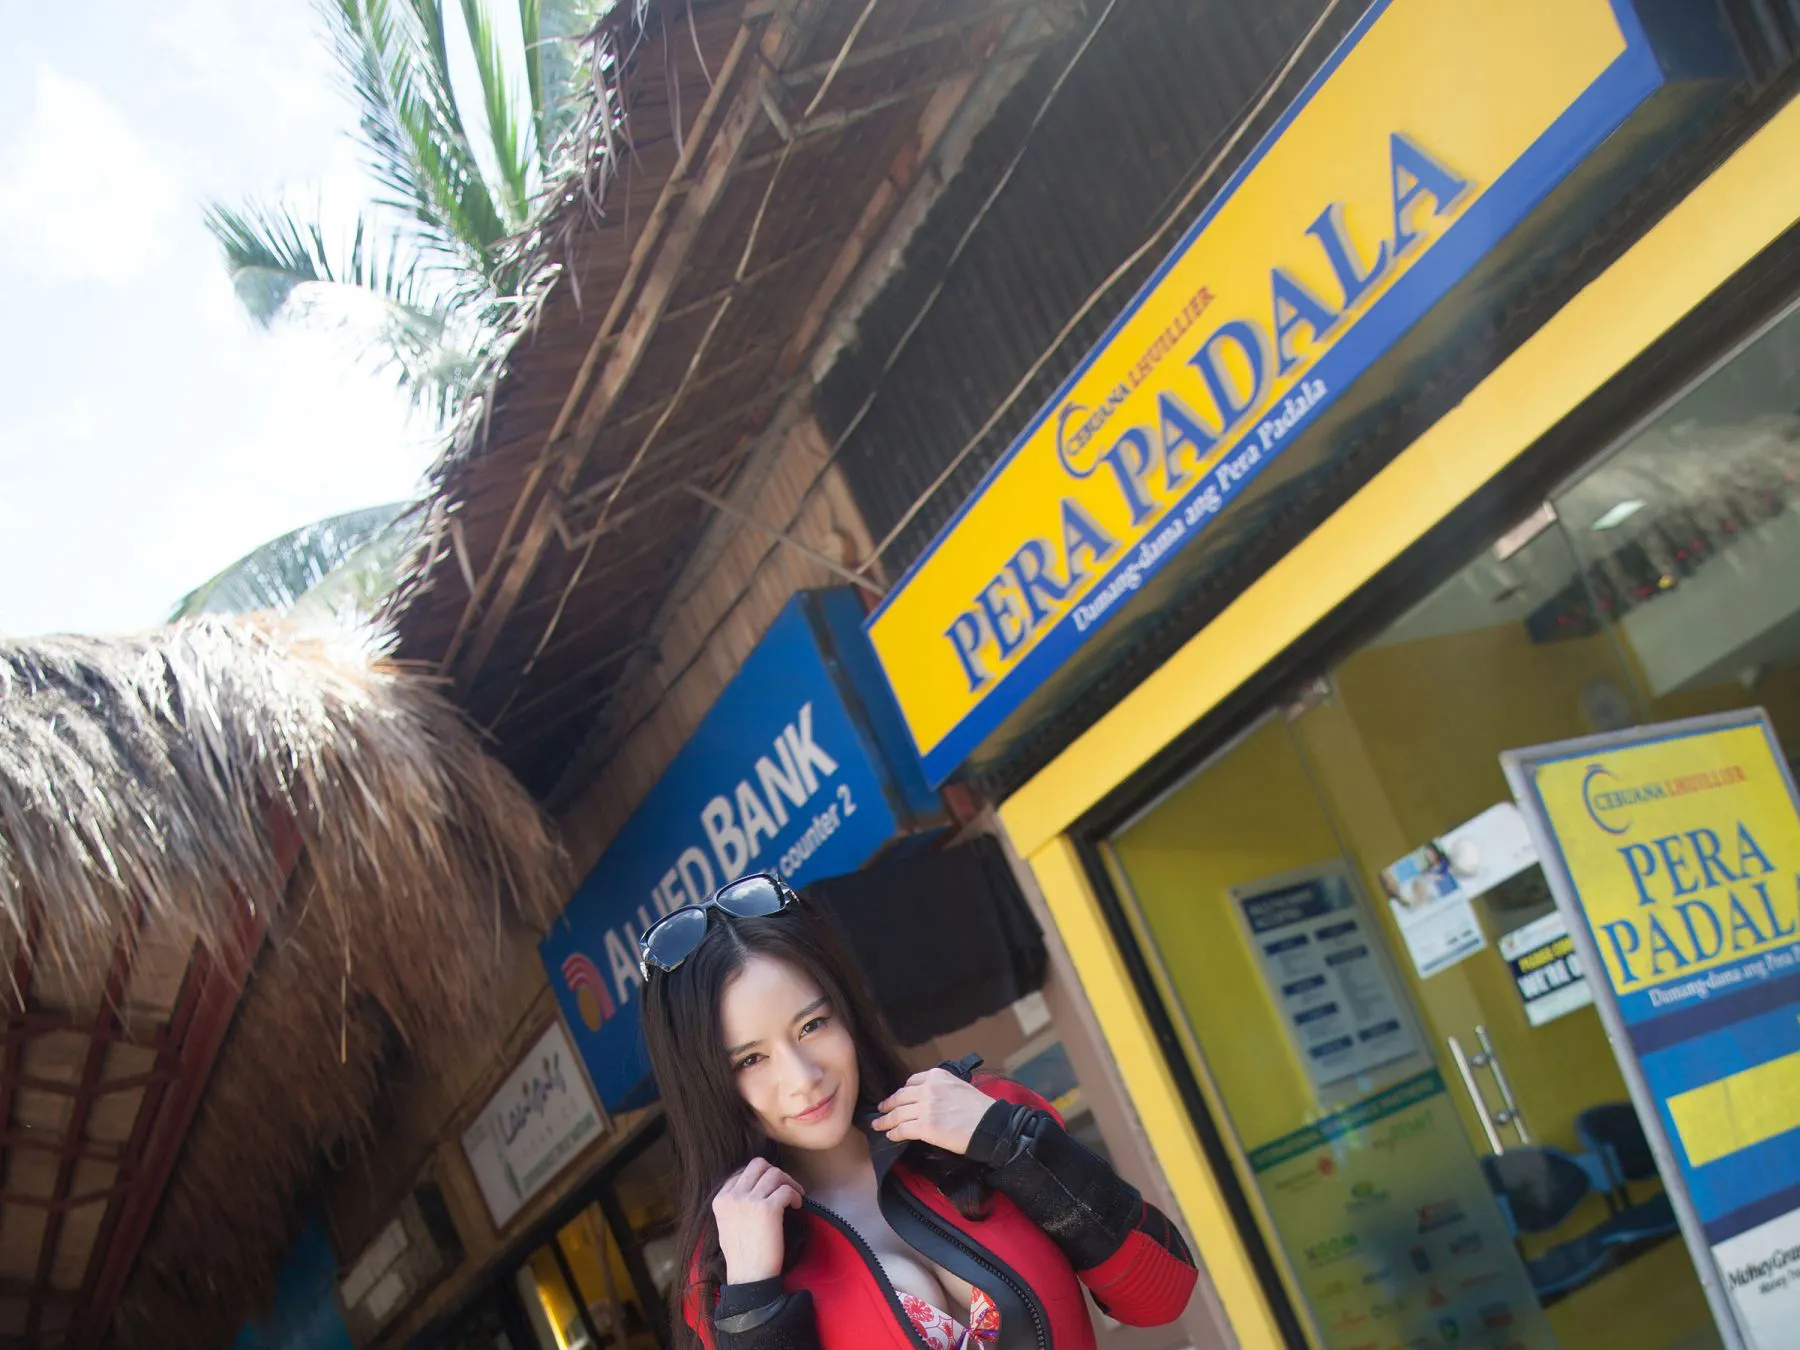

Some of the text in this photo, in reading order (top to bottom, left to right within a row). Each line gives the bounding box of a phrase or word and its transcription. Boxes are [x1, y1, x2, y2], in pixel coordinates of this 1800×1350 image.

[943, 131, 1475, 694] PERA PADALA
[1185, 484, 1224, 525] ang
[1215, 444, 1263, 491] Pera
[1256, 378, 1329, 451] Padala
[603, 701, 839, 1005] ALED BANK
[780, 784, 857, 877] counter 2
[1617, 819, 1777, 906] PERA
[1600, 871, 1800, 985] PADAL
[1728, 1244, 1800, 1292] MoneyGra
